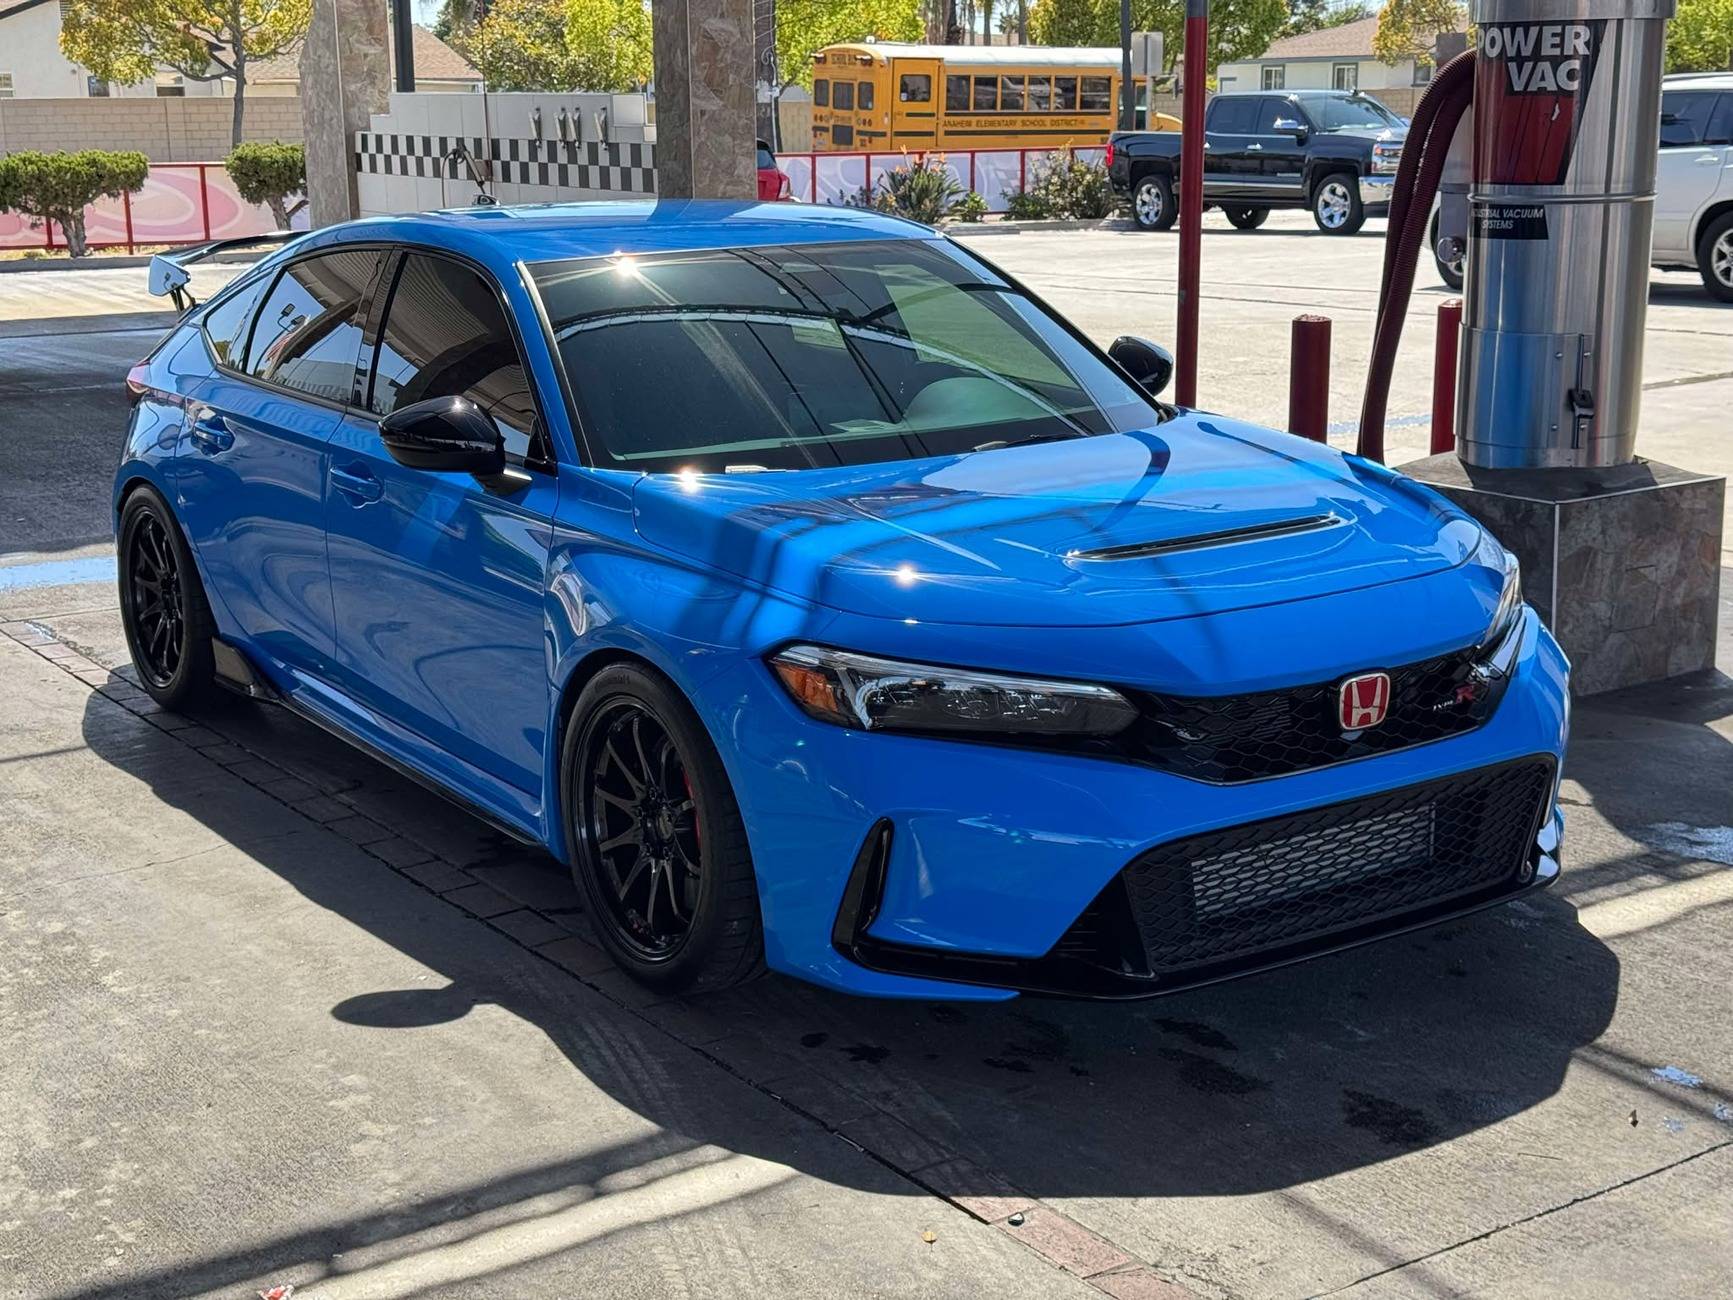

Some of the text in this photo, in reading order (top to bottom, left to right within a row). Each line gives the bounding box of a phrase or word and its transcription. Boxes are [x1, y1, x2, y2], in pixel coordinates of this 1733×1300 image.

[1507, 59, 1581, 92] VAC
[976, 119, 1017, 128] ELEMENTARY
[1021, 119, 1047, 128] SCHOOL
[1050, 119, 1078, 127] DISTRICT
[1503, 208, 1544, 219] VACUUM
[1481, 219, 1514, 230] SYSTEMS
